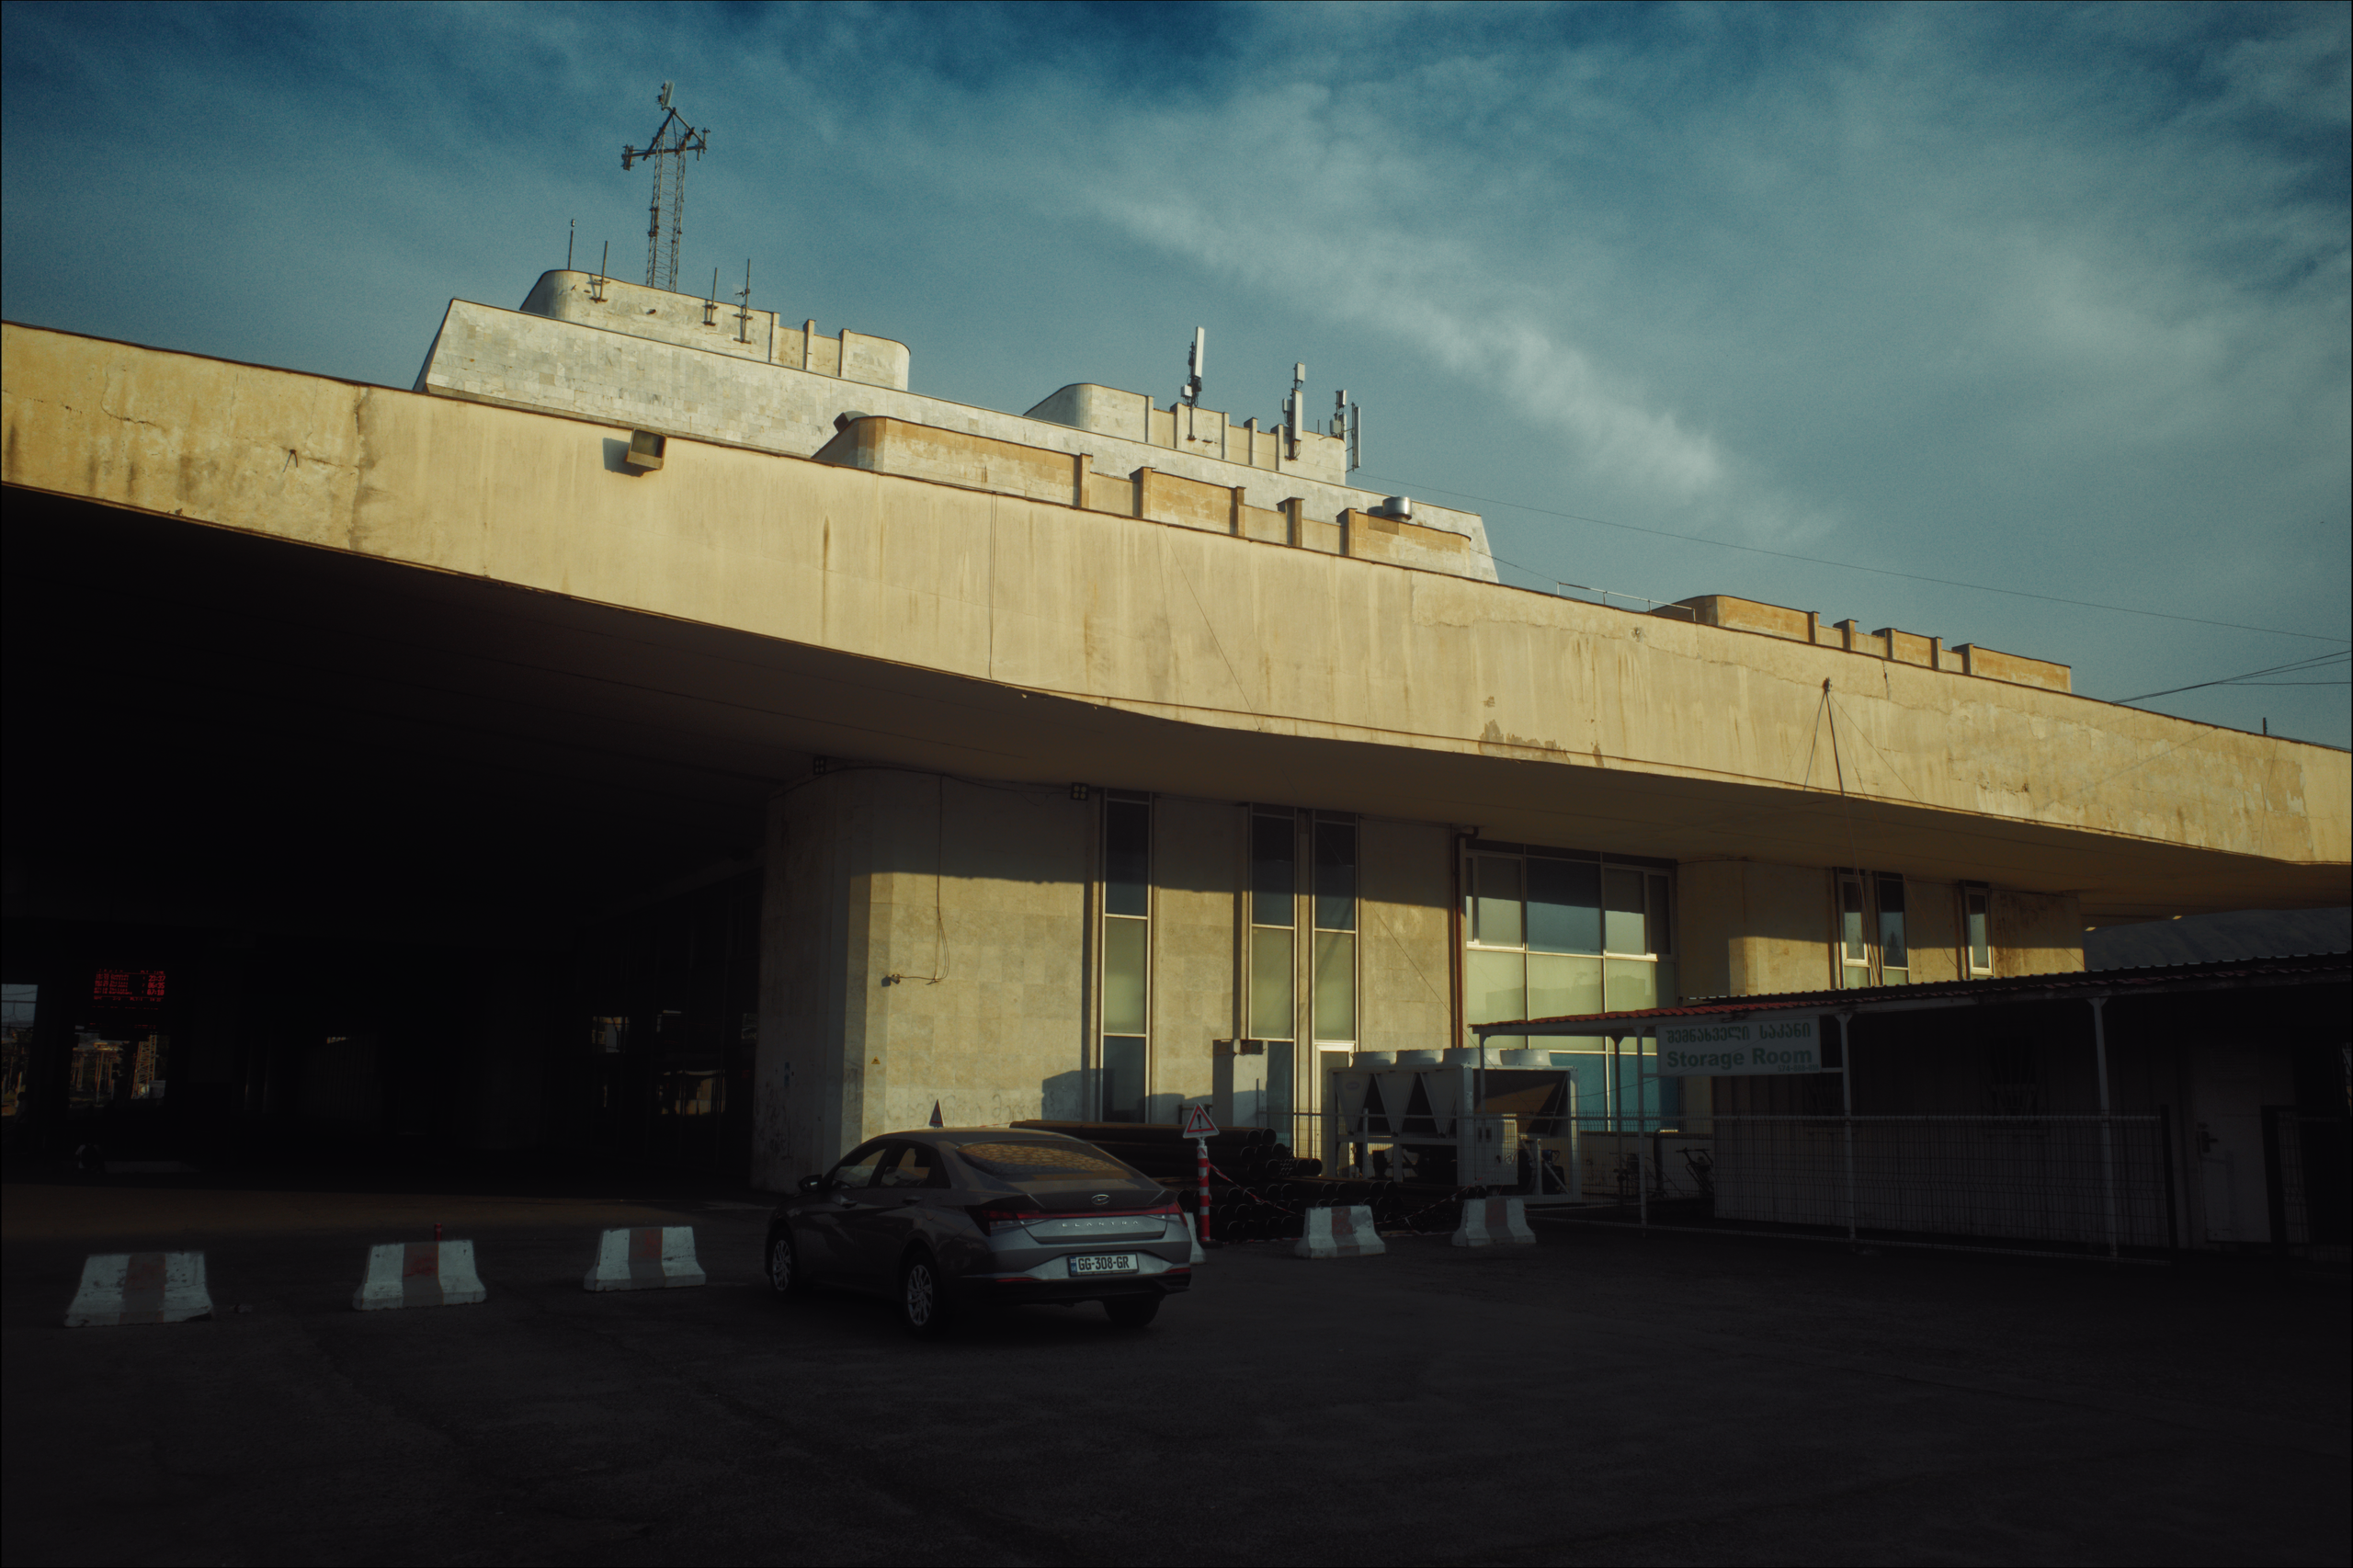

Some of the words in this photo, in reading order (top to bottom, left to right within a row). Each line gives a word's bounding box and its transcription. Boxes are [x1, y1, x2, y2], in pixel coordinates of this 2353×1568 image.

[1665, 1026, 1750, 1043] შემნახველი
[1758, 1022, 1812, 1040] საკანი
[1666, 1051, 1745, 1070] Storage
[1752, 1048, 1813, 1065] Room
[1078, 1256, 1130, 1270] GG-308-GR
